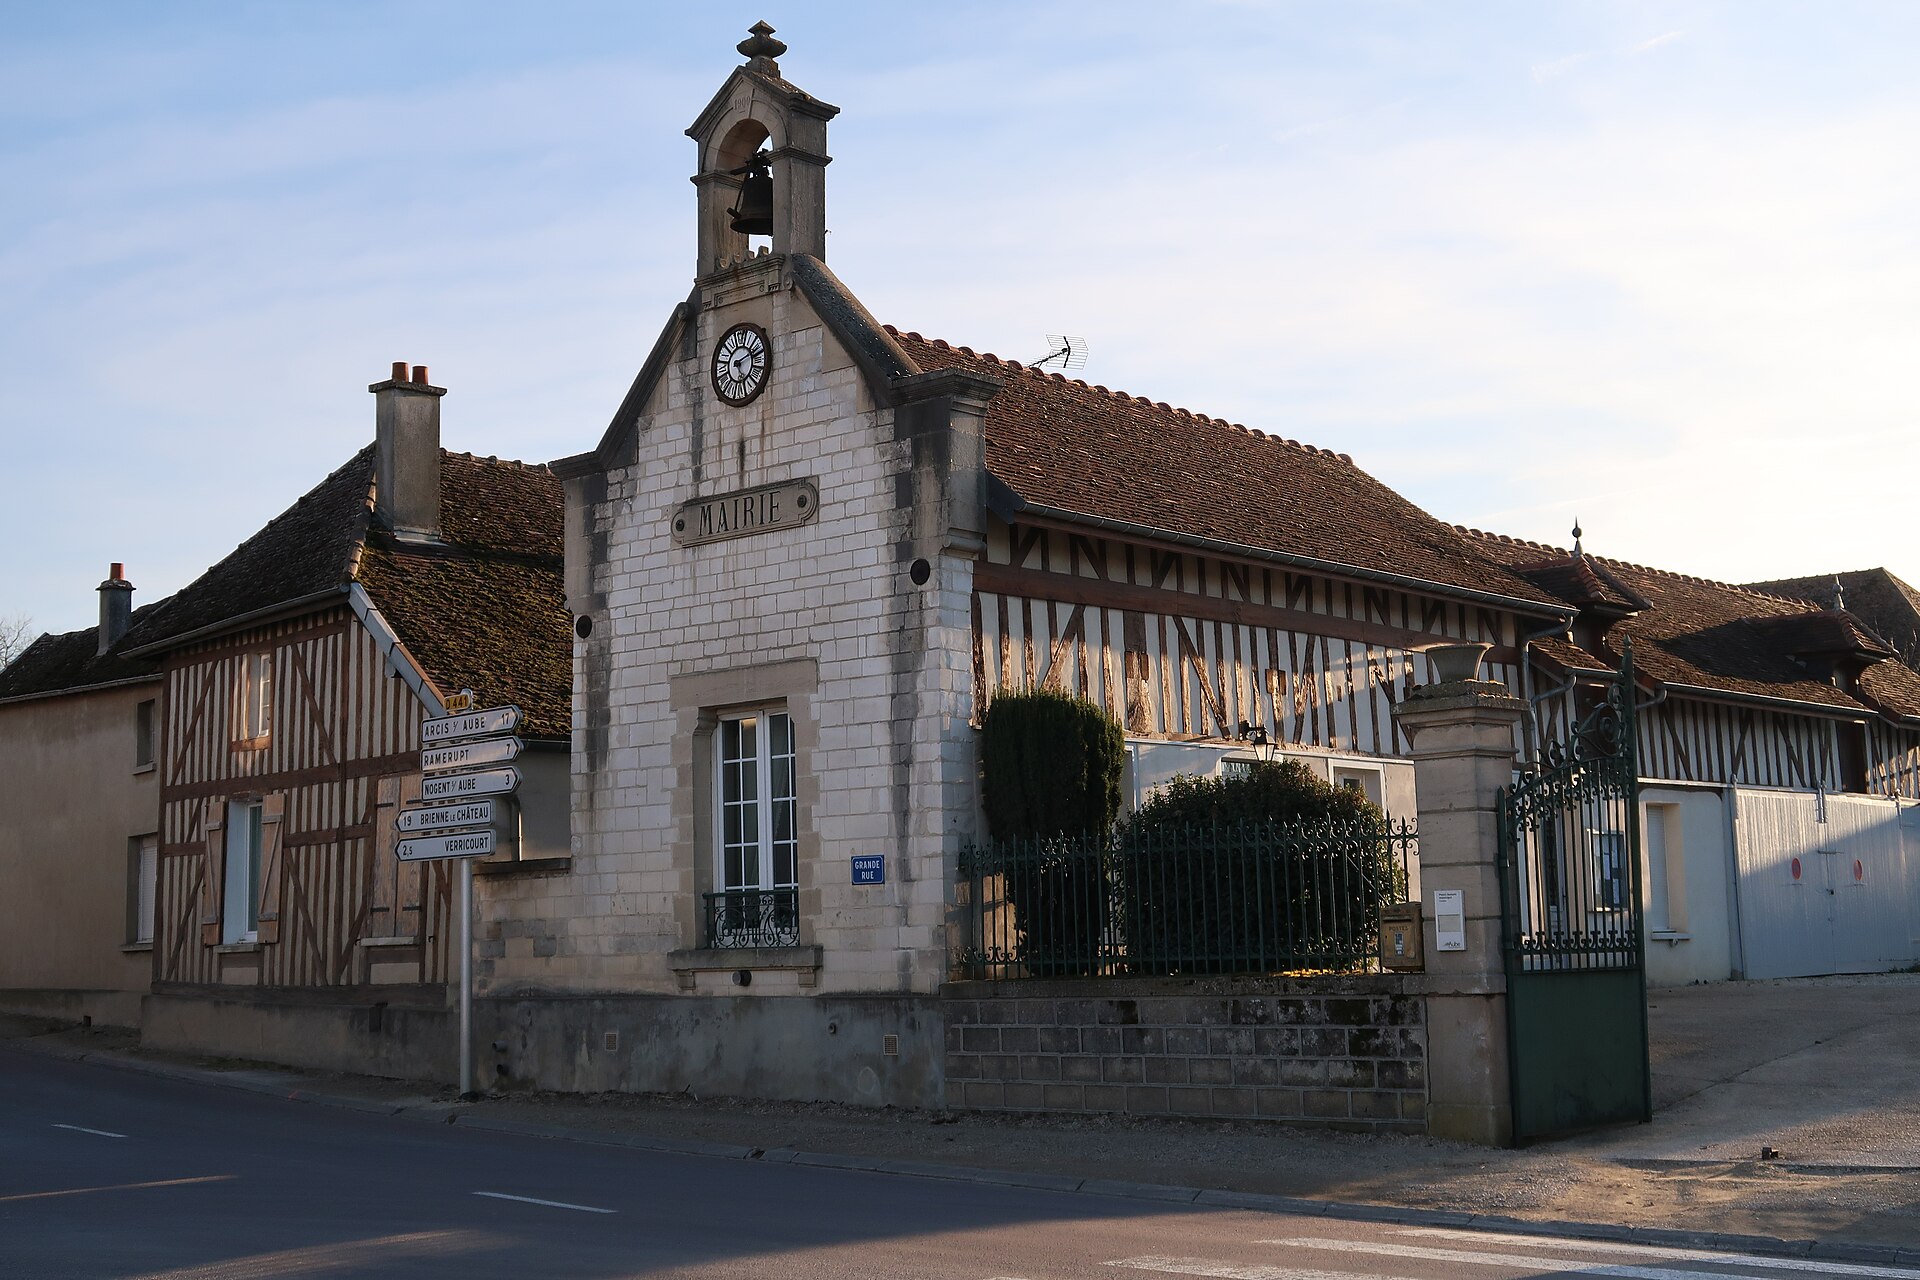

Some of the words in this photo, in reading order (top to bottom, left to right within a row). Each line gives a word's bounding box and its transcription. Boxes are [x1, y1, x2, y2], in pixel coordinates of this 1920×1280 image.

[698, 491, 782, 536] MAIRIE
[424, 722, 449, 737] ARCIS
[462, 716, 486, 730] AUBE
[501, 712, 510, 725] 17
[423, 749, 469, 767] RAMERUPT
[505, 743, 511, 755] 7
[424, 780, 451, 796] NOGENT
[457, 778, 476, 790] AUBE
[505, 774, 510, 786] 3
[402, 815, 412, 827] 19
[420, 811, 449, 825] BRIENNE
[449, 813, 456, 822] LE
[457, 806, 489, 821] CHÂTEAU
[402, 844, 413, 857] 2,5
[444, 836, 489, 852] VERRICOURT
[854, 860, 880, 870] GRANDE
[861, 871, 874, 881] RUE
